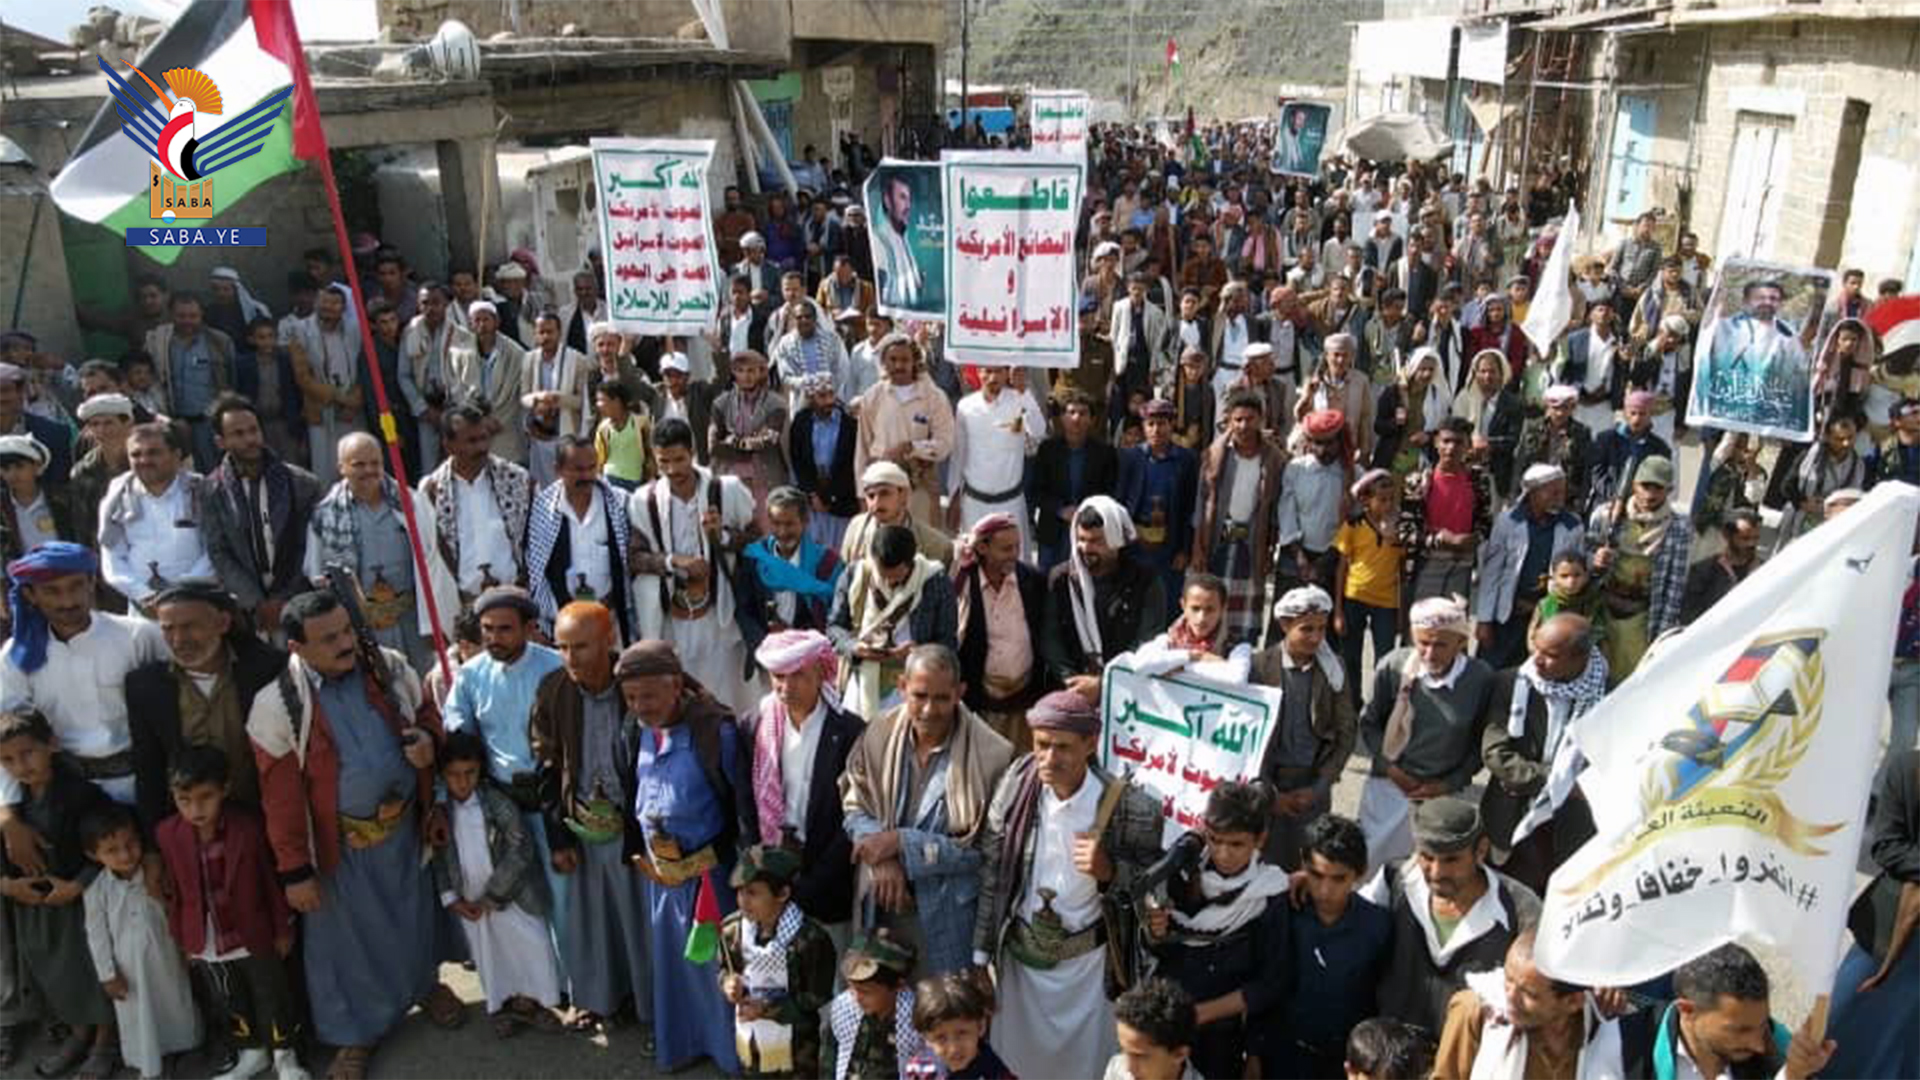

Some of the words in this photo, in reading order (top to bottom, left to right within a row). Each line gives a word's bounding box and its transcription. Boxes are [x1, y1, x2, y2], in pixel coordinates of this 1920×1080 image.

[960, 177, 1069, 218] قاطعوا
[1018, 228, 1071, 262] البضائع
[1007, 268, 1015, 294] و
[1115, 694, 1223, 738] أكبر
[1211, 708, 1258, 754] الله
